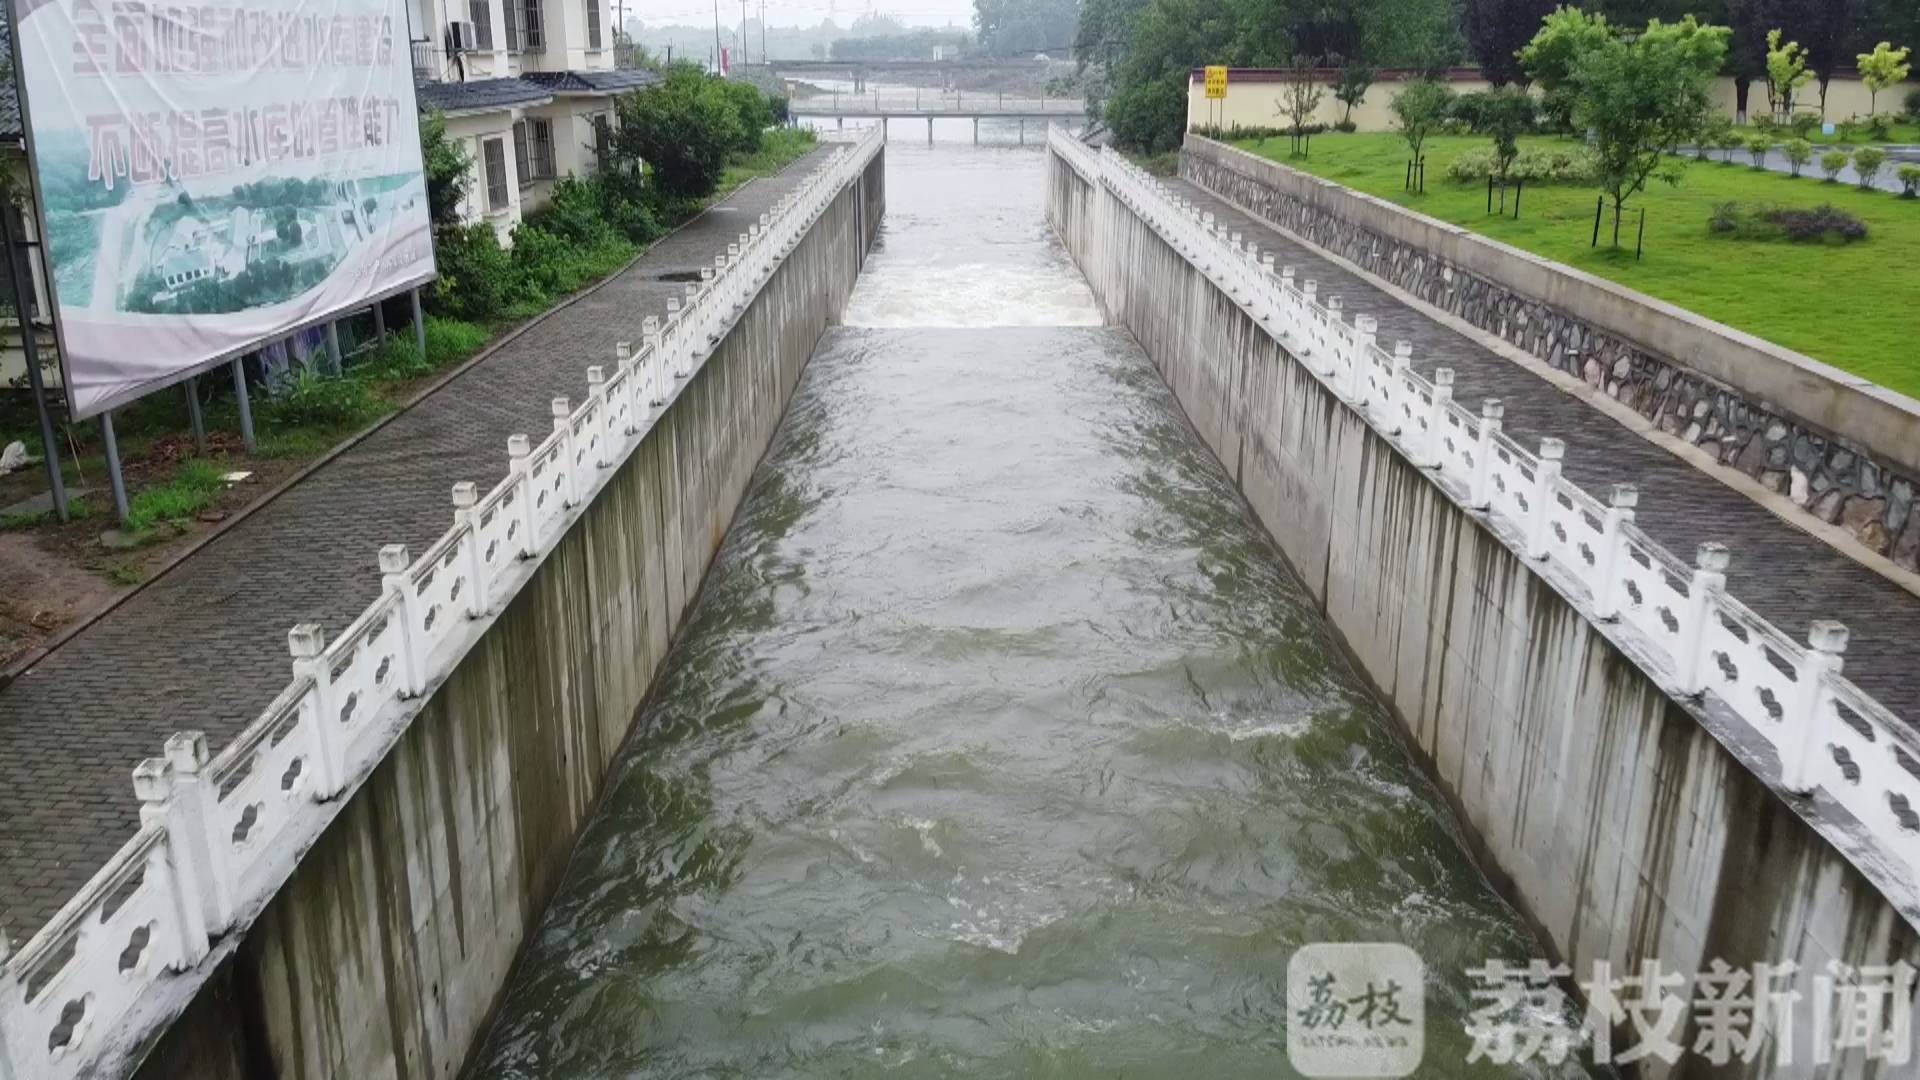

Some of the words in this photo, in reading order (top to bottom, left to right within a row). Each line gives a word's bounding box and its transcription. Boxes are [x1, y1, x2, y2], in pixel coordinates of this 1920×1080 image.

[86, 96, 400, 190] 不断提高水库的管理能力
